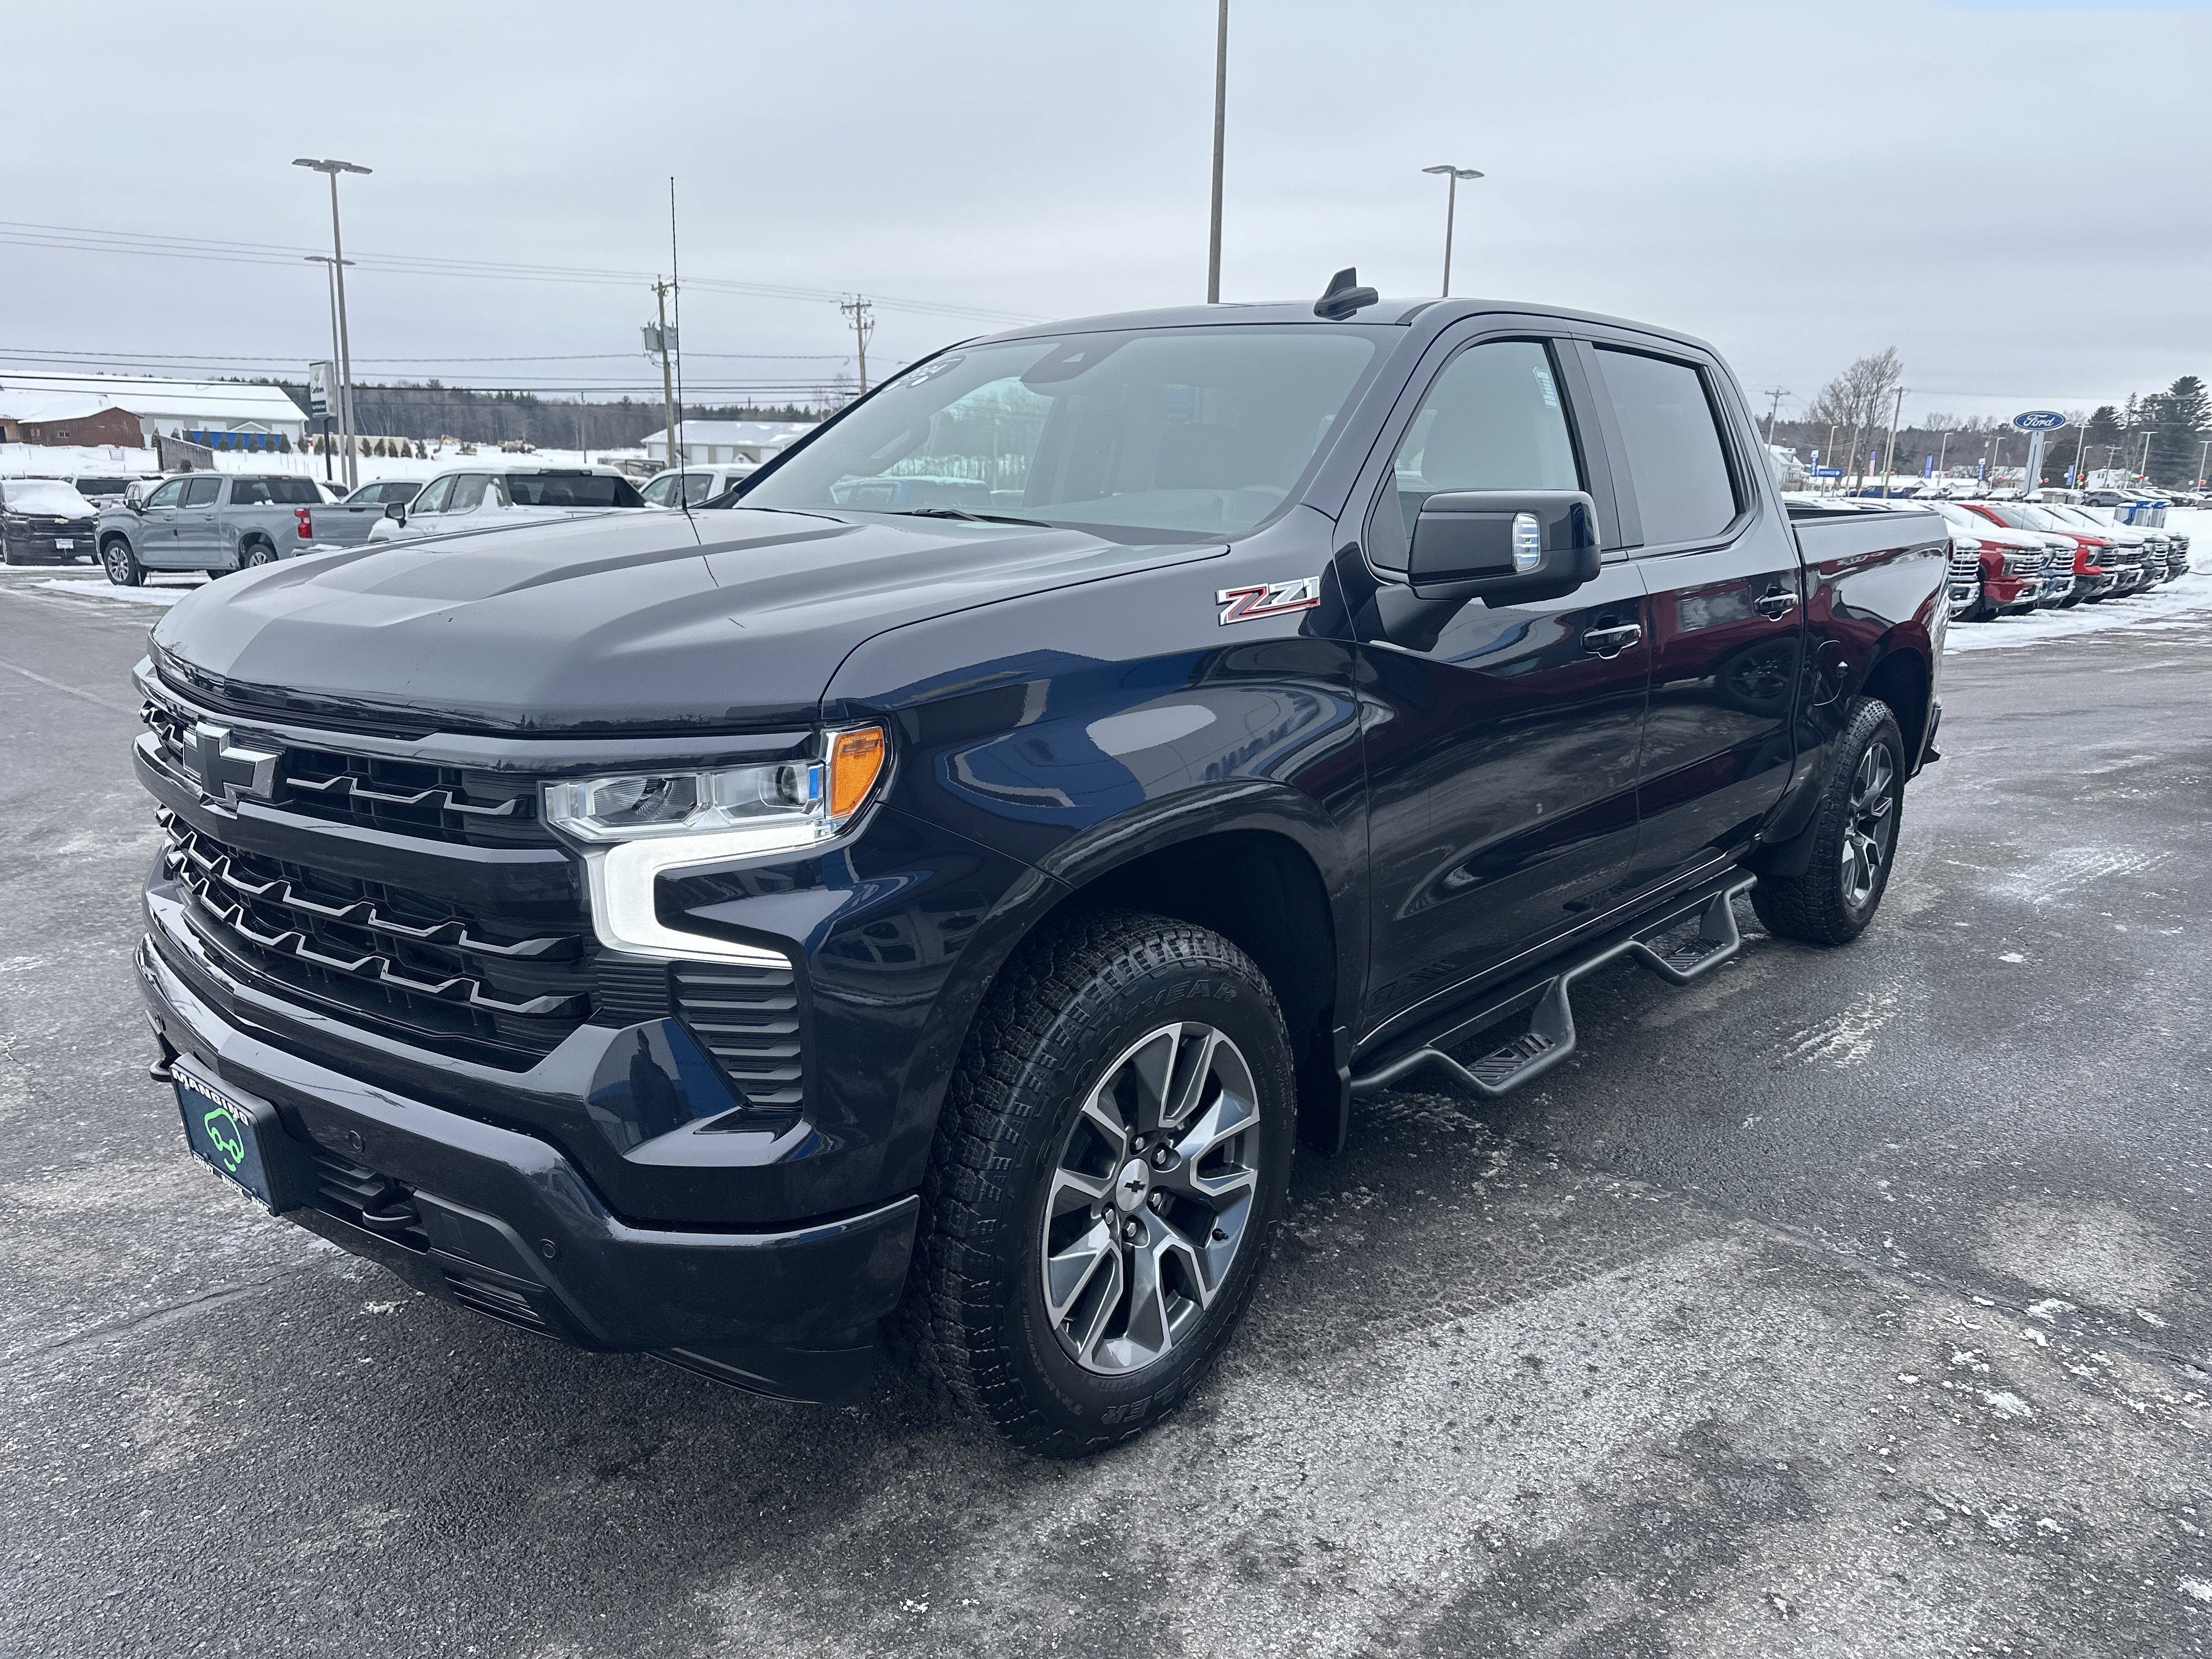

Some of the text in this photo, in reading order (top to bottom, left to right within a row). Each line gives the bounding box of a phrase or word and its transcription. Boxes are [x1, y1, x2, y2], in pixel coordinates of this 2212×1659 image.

[2023, 414, 2055, 427] Ford
[1215, 575, 1320, 627] Z71
[1035, 979, 1238, 1182] GOODYEAR
[193, 1154, 270, 1215] CHEVY BUICK GMC
